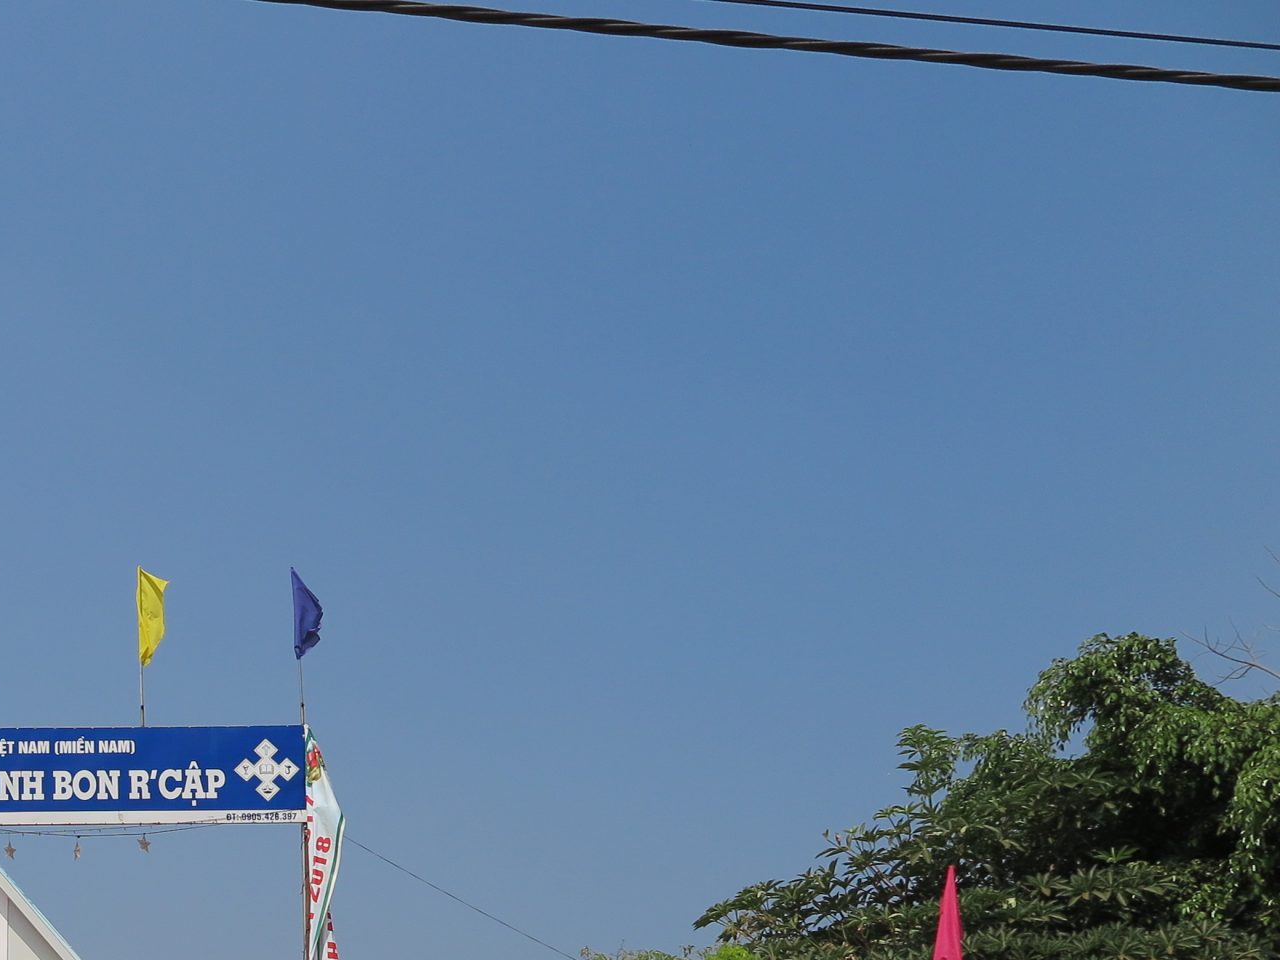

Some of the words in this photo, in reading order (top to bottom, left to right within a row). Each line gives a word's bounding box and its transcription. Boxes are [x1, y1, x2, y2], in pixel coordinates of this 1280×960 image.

[18, 741, 50, 754] NAM
[54, 736, 94, 755] (MIỀN
[98, 740, 135, 755] NAM)
[52, 770, 120, 801] BON
